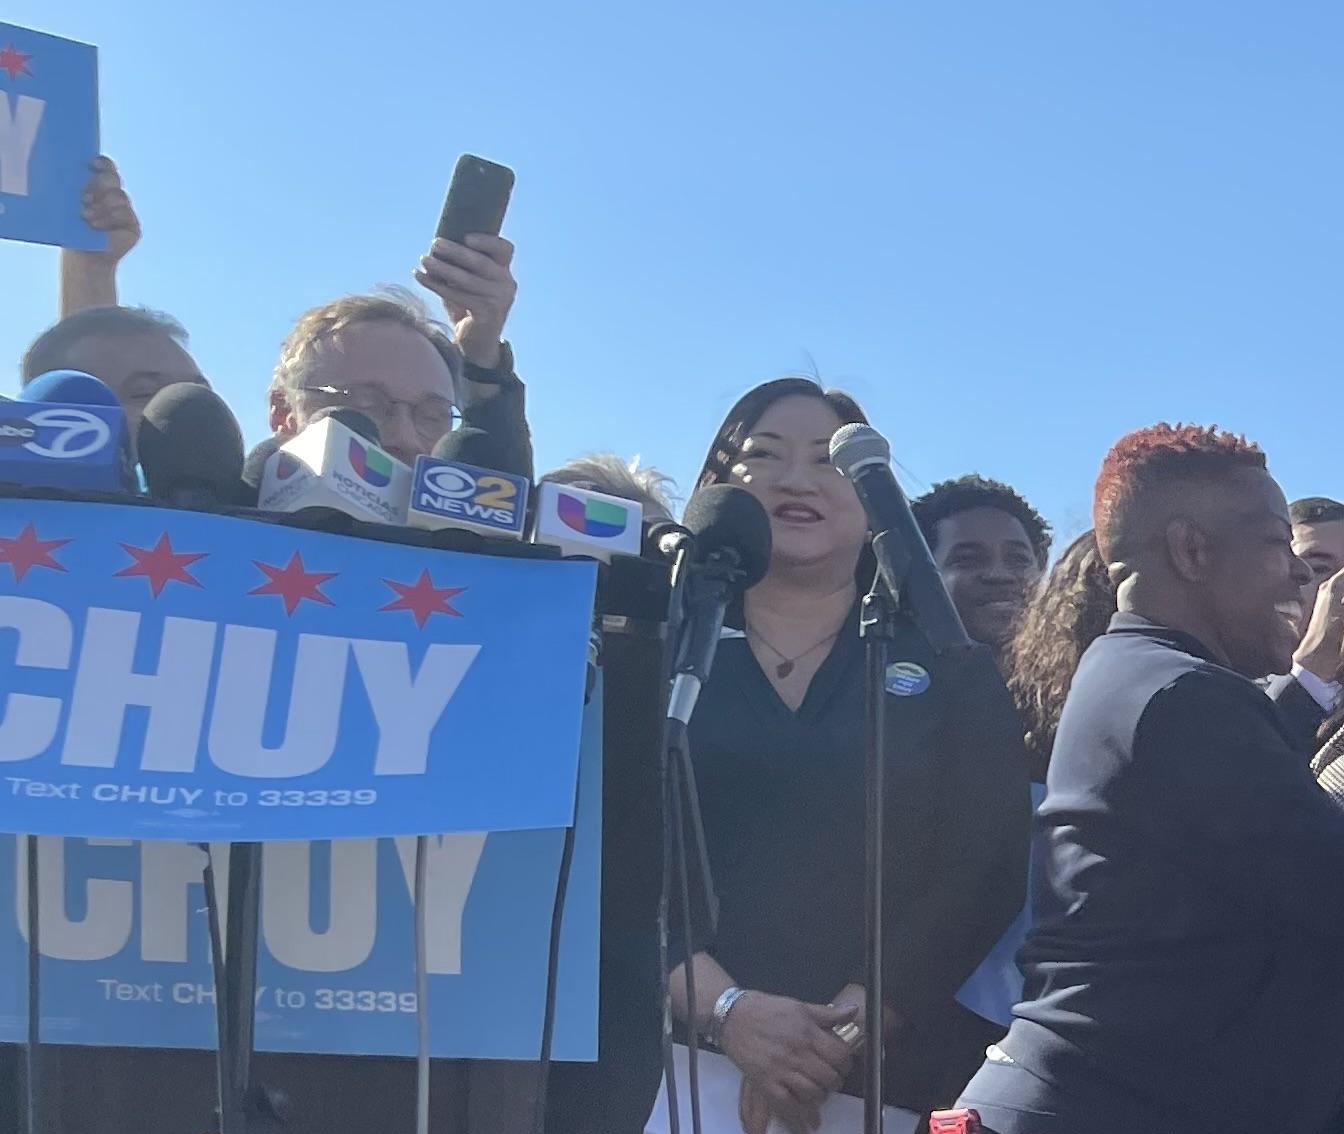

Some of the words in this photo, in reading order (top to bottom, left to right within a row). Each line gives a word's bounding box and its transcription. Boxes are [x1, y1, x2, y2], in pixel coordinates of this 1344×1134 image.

[332, 470, 399, 516] NOTICIAS
[421, 493, 514, 525] NEWS
[474, 476, 518, 511] 2
[5, 777, 81, 800] Text
[91, 784, 204, 806] CHUY
[214, 790, 249, 807] to
[258, 789, 378, 807] 33339
[97, 979, 163, 1003] Text
[274, 987, 306, 1009] to
[314, 988, 418, 1014] 33339
